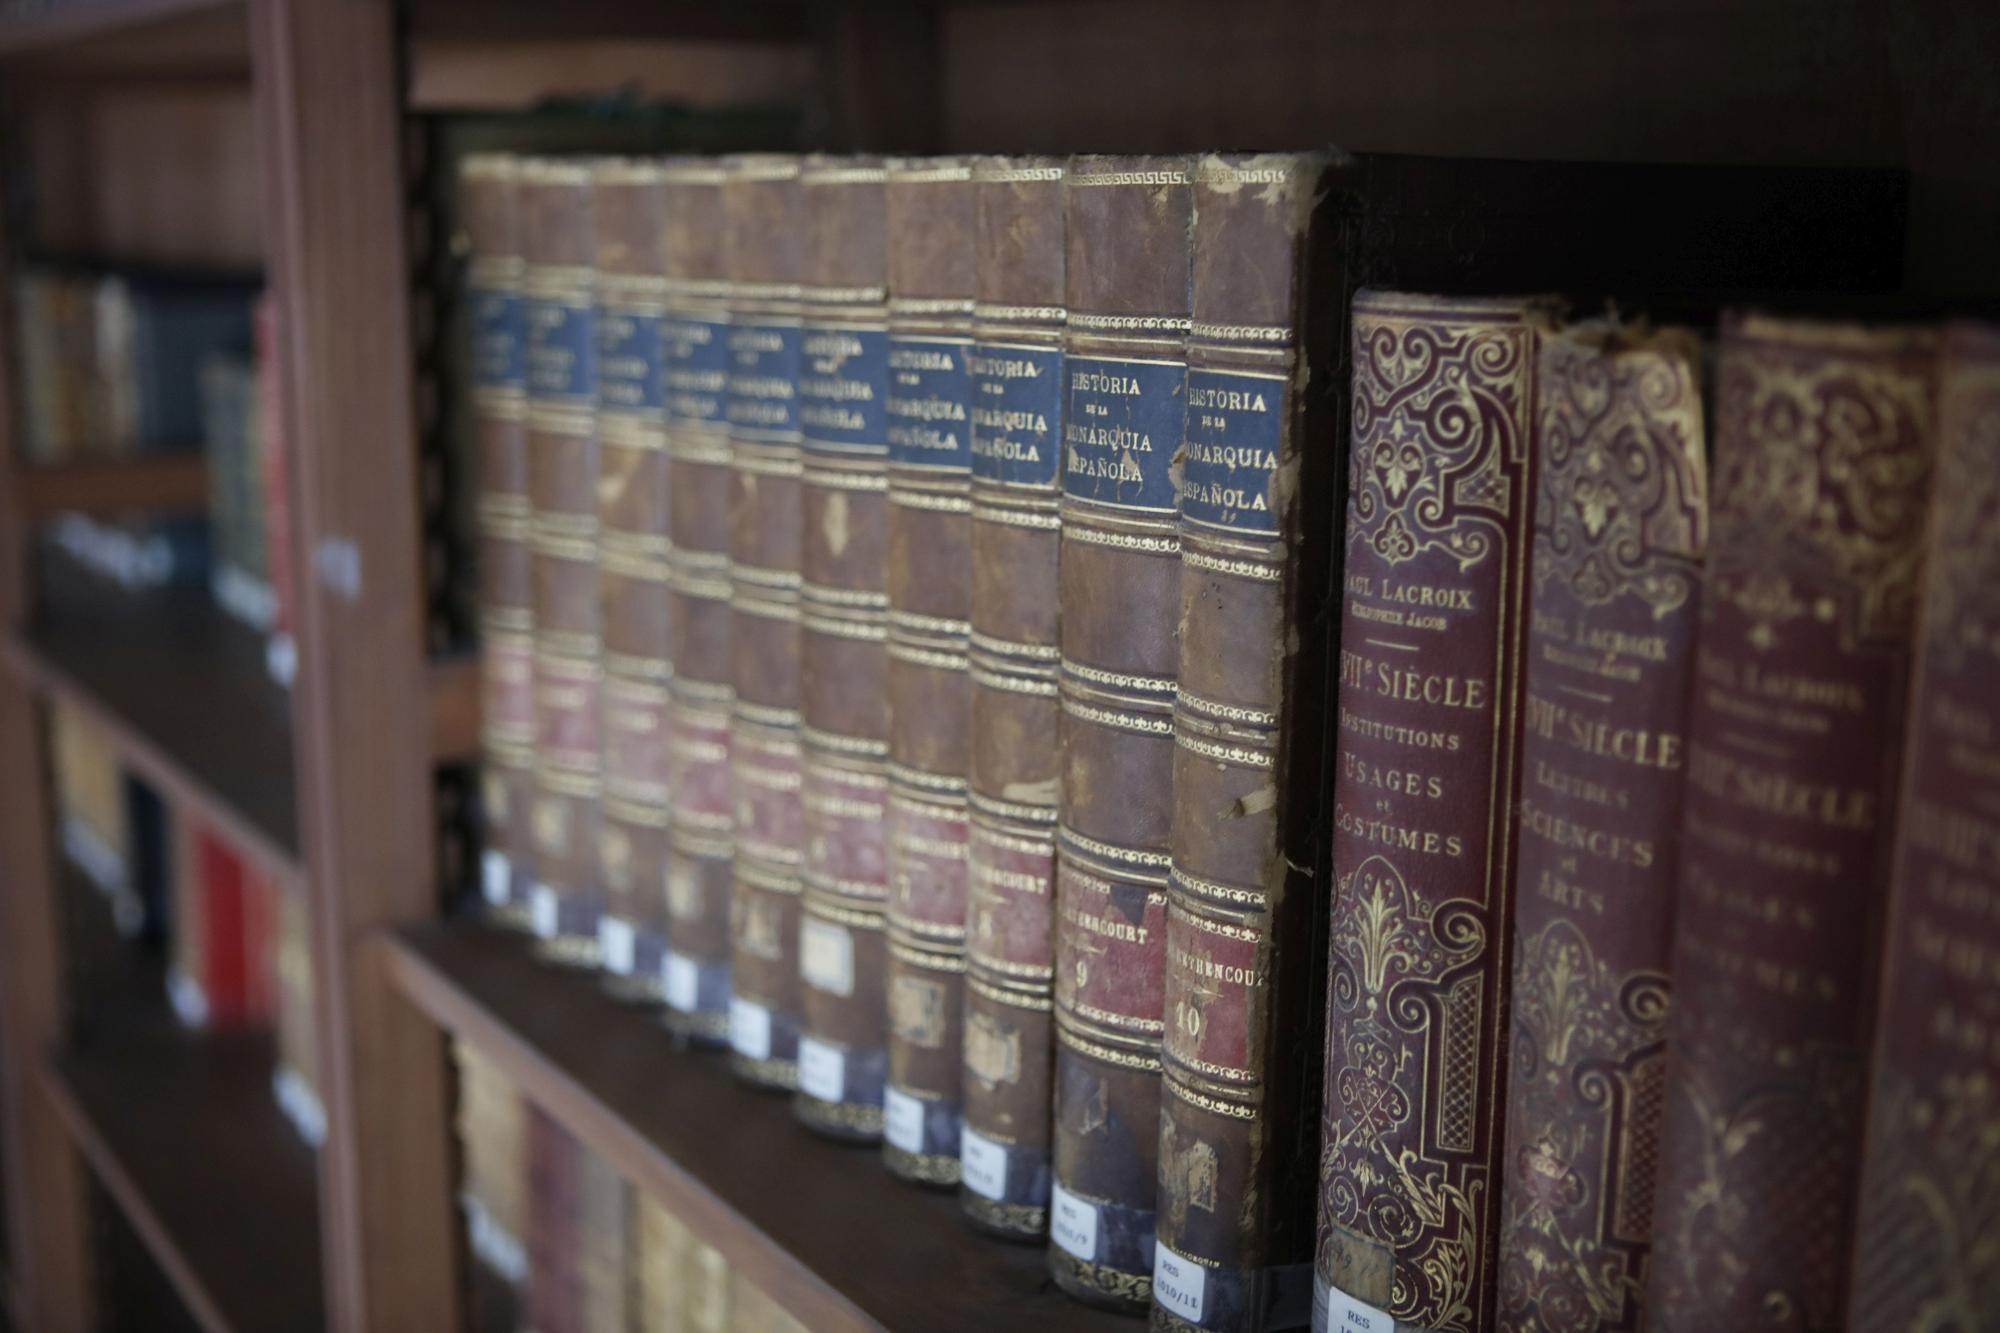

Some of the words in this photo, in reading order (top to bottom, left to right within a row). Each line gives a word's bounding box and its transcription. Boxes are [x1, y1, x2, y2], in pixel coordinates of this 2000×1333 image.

[1072, 372, 1141, 396] HISTORIA
[1098, 405, 1108, 416] LA
[1189, 387, 1267, 412] HISTORIA
[1202, 415, 1212, 427] DE
[1214, 417, 1226, 428] LA
[1382, 578, 1473, 611] LACROIX
[1341, 707, 1460, 751] INSTITUTIONS
[1343, 750, 1443, 799] USAGES
[1334, 802, 1463, 857] COSTUMES
[1076, 961, 1088, 988] 9
[1175, 1001, 1201, 1036] 10
[1347, 1310, 1370, 1329] RES
